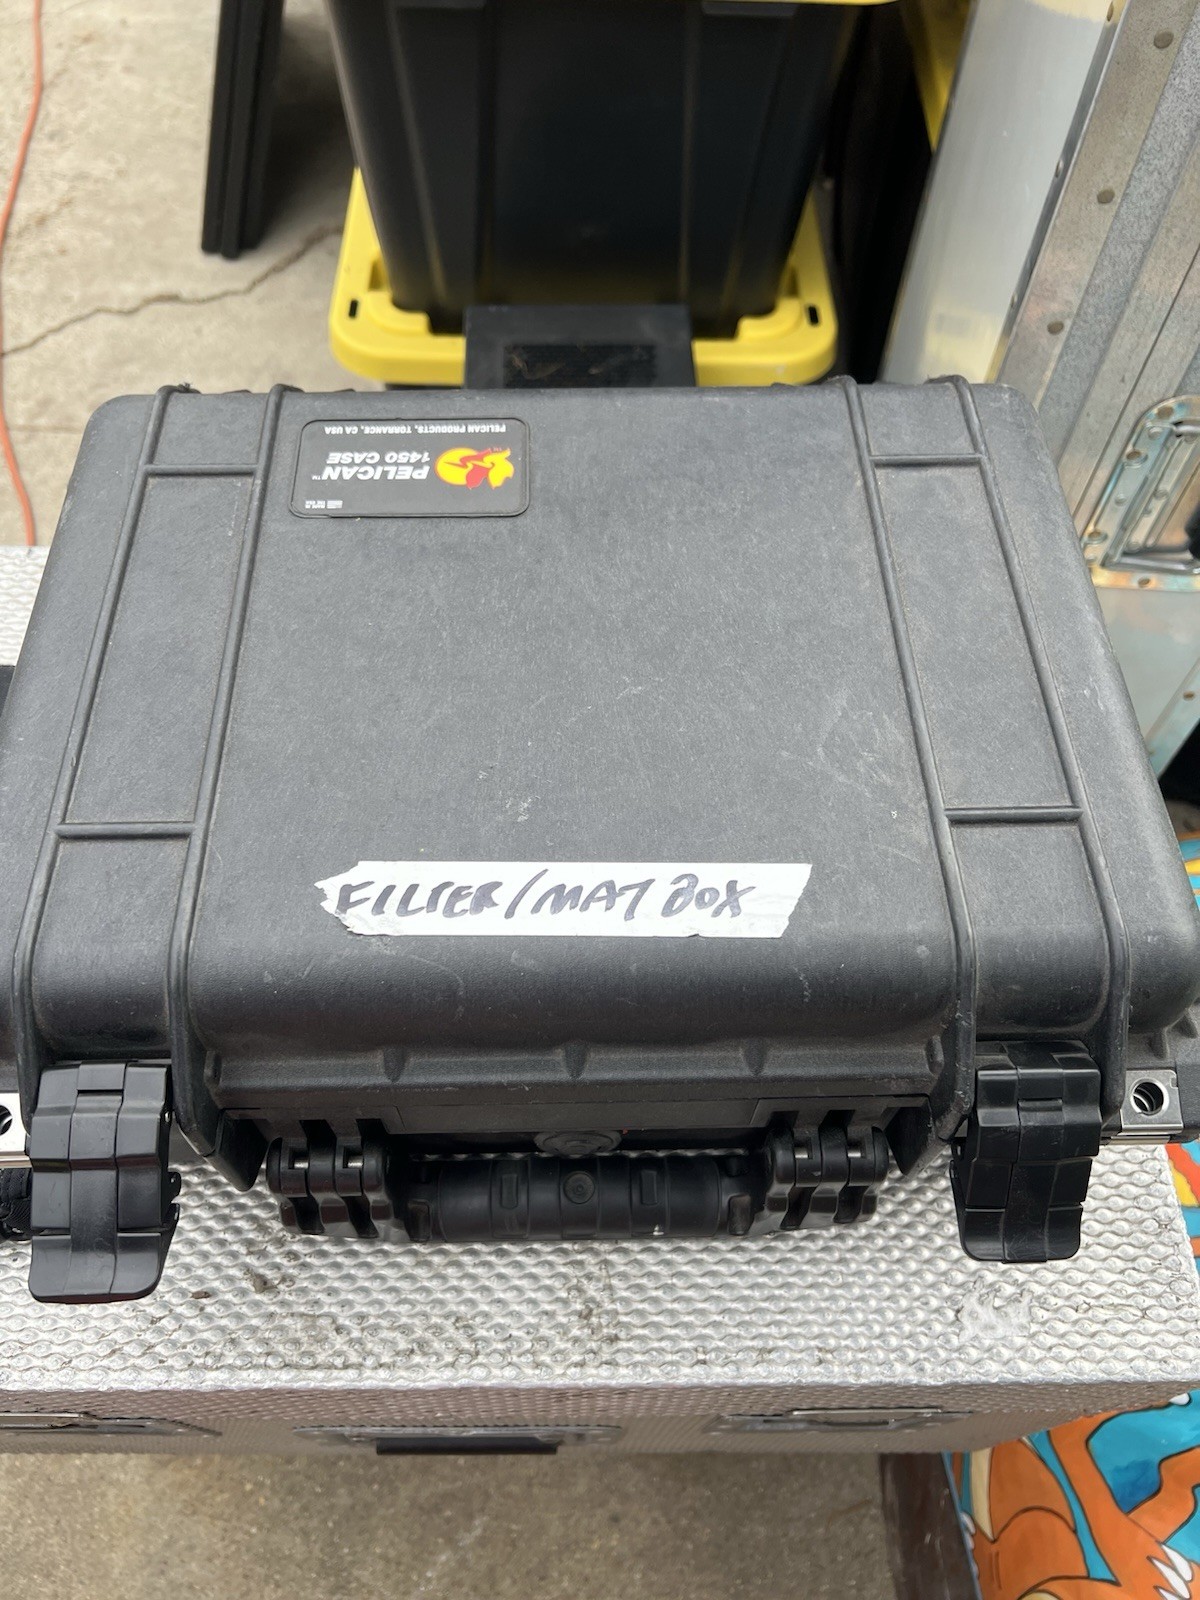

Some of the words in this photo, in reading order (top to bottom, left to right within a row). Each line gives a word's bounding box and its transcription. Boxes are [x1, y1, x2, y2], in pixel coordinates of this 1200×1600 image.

[324, 426, 343, 434] USA
[345, 426, 358, 434] CA
[360, 425, 412, 434] TORRANCE,
[415, 424, 466, 433] PRODUCTS,
[467, 424, 506, 433] PELICAN
[326, 452, 380, 464] CASE
[385, 452, 431, 464] 1450
[661, 873, 756, 919] BOX
